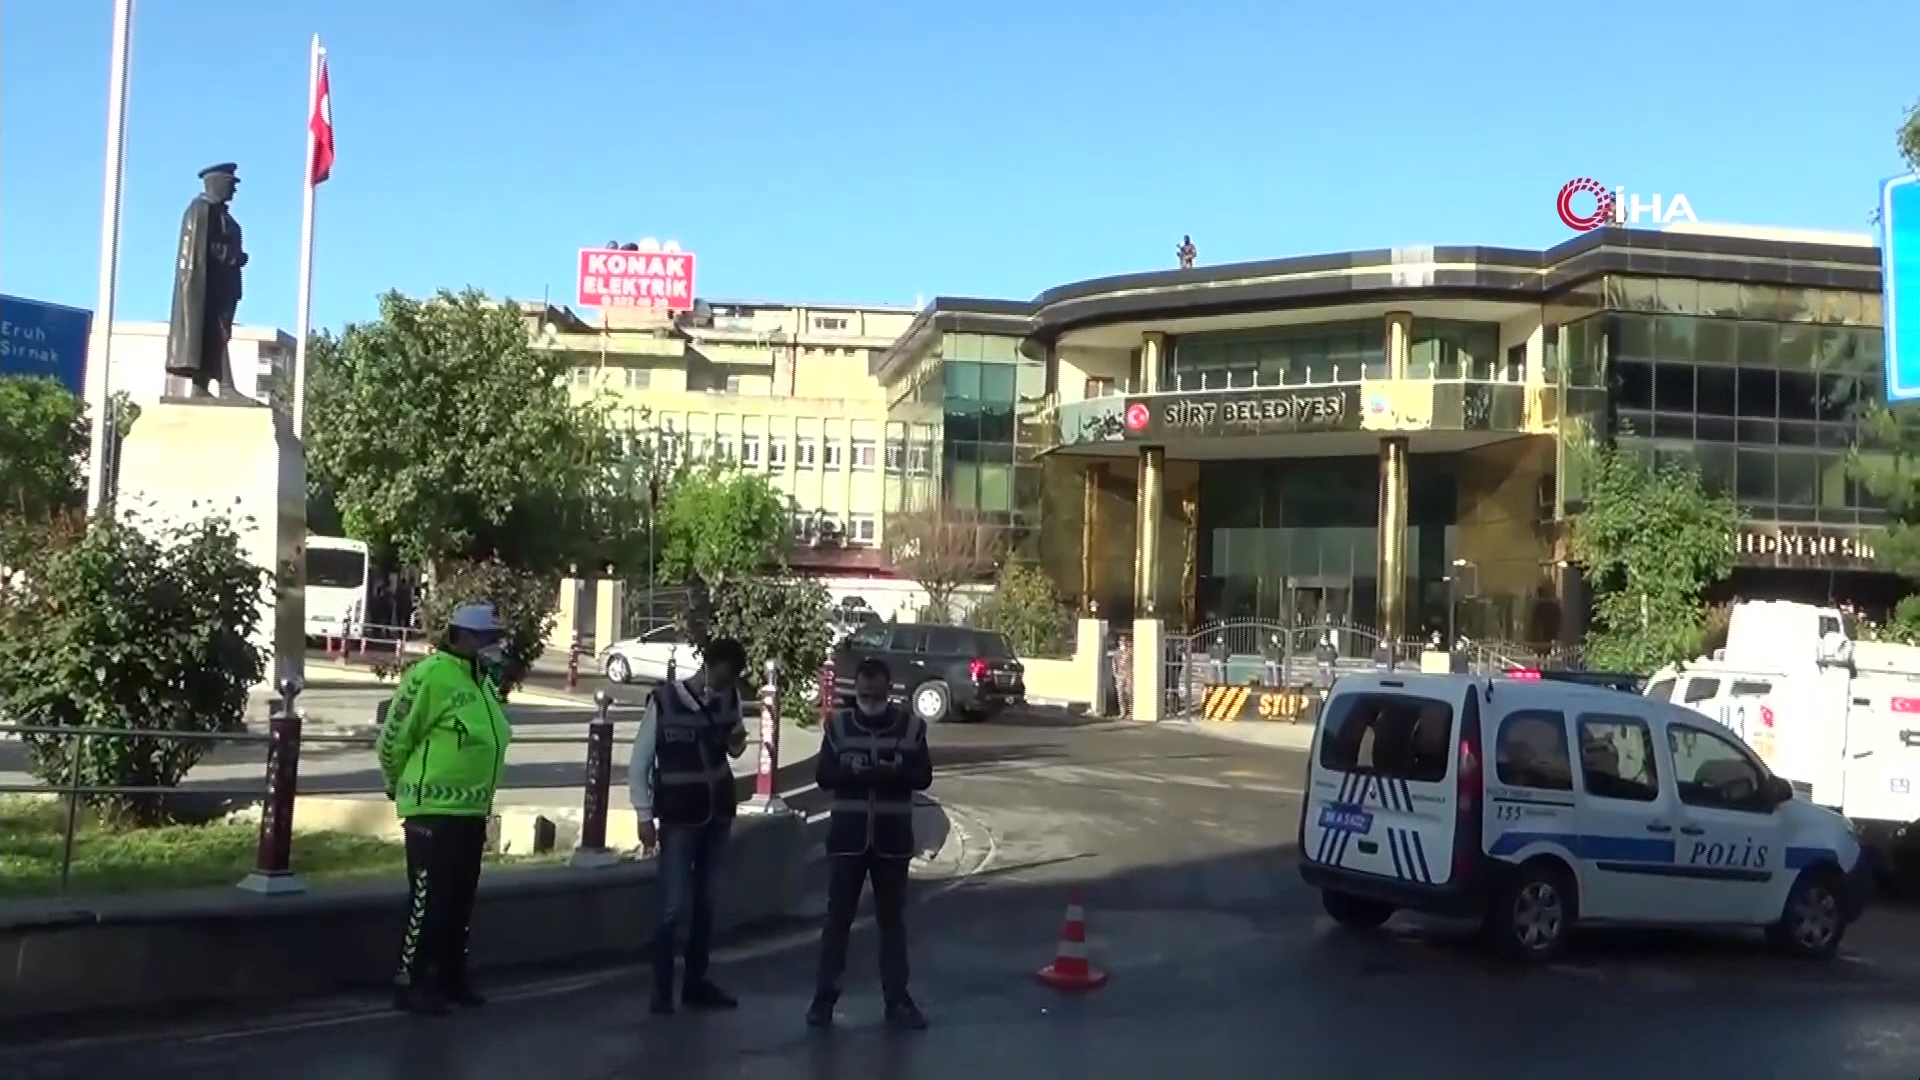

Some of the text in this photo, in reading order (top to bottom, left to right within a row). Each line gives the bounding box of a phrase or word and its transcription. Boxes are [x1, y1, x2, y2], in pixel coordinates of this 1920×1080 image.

[588, 253, 685, 277] KONAK
[1, 320, 46, 341] Eruh
[1222, 391, 1346, 424] BELEDİYESİ
[1690, 837, 1769, 868] POLİS
